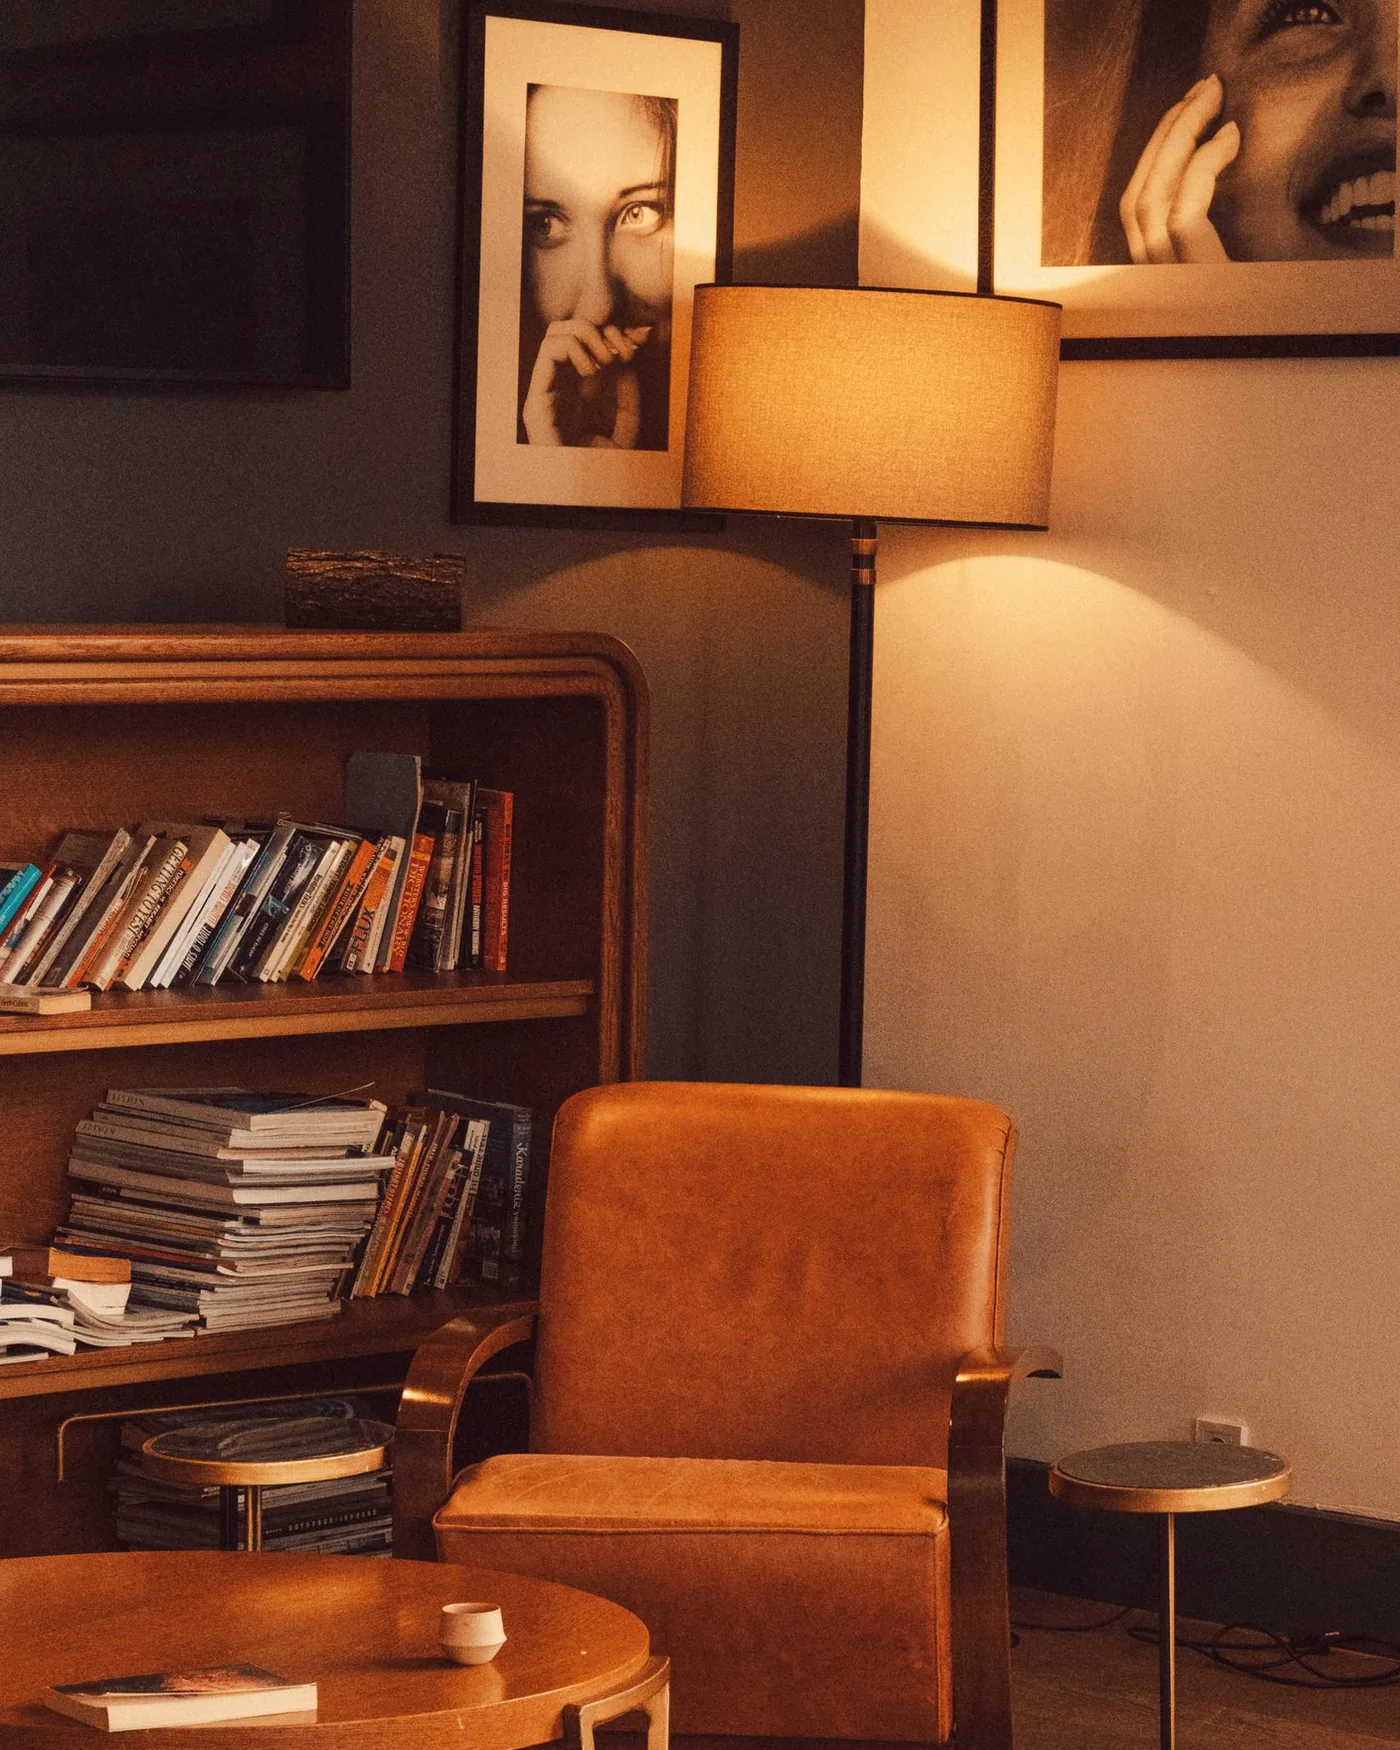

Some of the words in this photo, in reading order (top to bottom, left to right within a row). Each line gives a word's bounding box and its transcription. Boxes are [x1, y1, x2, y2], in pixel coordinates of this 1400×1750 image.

[151, 846, 184, 893] GETTING
[335, 849, 352, 878] INSTANT
[142, 893, 157, 910] TO
[322, 879, 336, 902] TENNIS
[339, 887, 351, 904] BOOK
[306, 903, 324, 932] LESSONS
[327, 914, 337, 928] THE
[393, 863, 418, 953] DICTIONARY
[350, 906, 376, 953] FLUX
[182, 953, 198, 970] JAMES
[513, 1142, 528, 1209] Karadeniz
